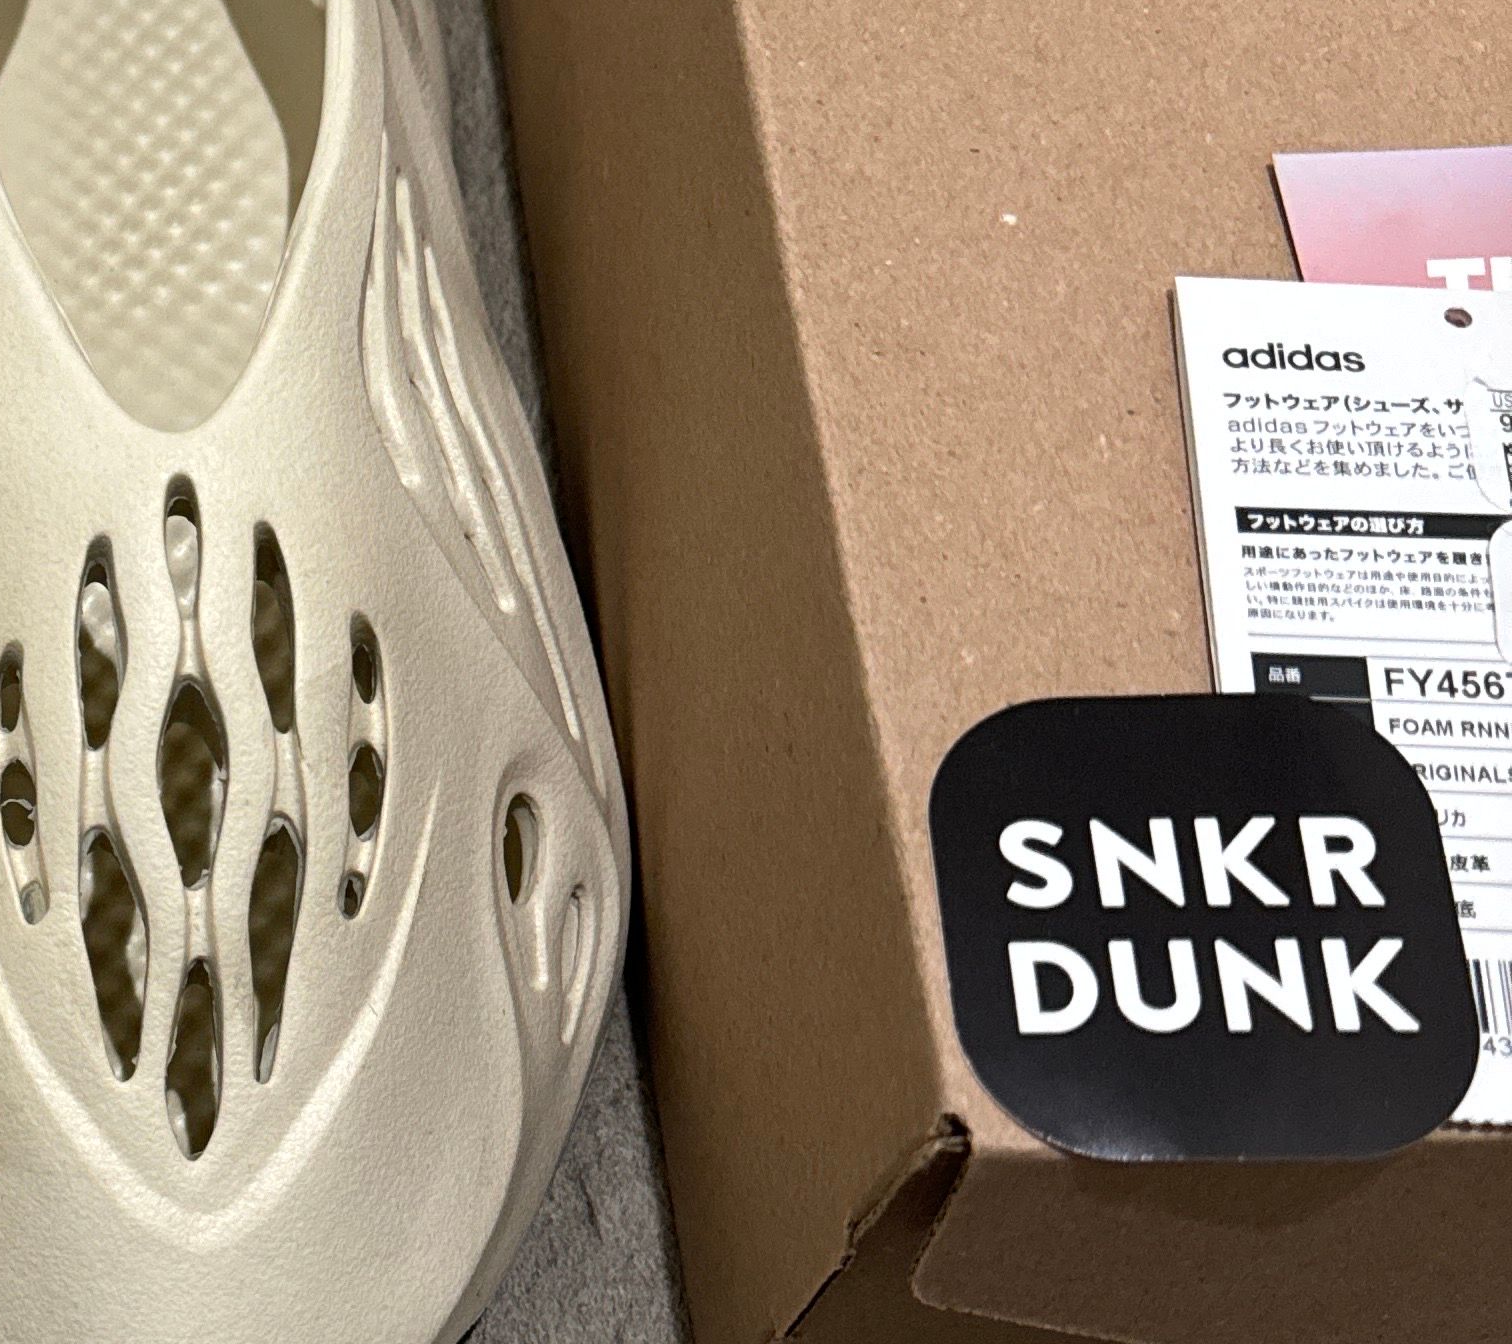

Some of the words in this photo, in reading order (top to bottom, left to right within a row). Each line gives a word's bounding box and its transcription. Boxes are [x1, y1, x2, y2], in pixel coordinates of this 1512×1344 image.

[1222, 342, 1366, 373] adidas
[1228, 417, 1307, 434] adidas
[1389, 718, 1454, 737] FOAM
[1412, 762, 1512, 784] RIGINAL
[999, 816, 1386, 909] SNKR
[1008, 937, 1421, 1034] DUNK
